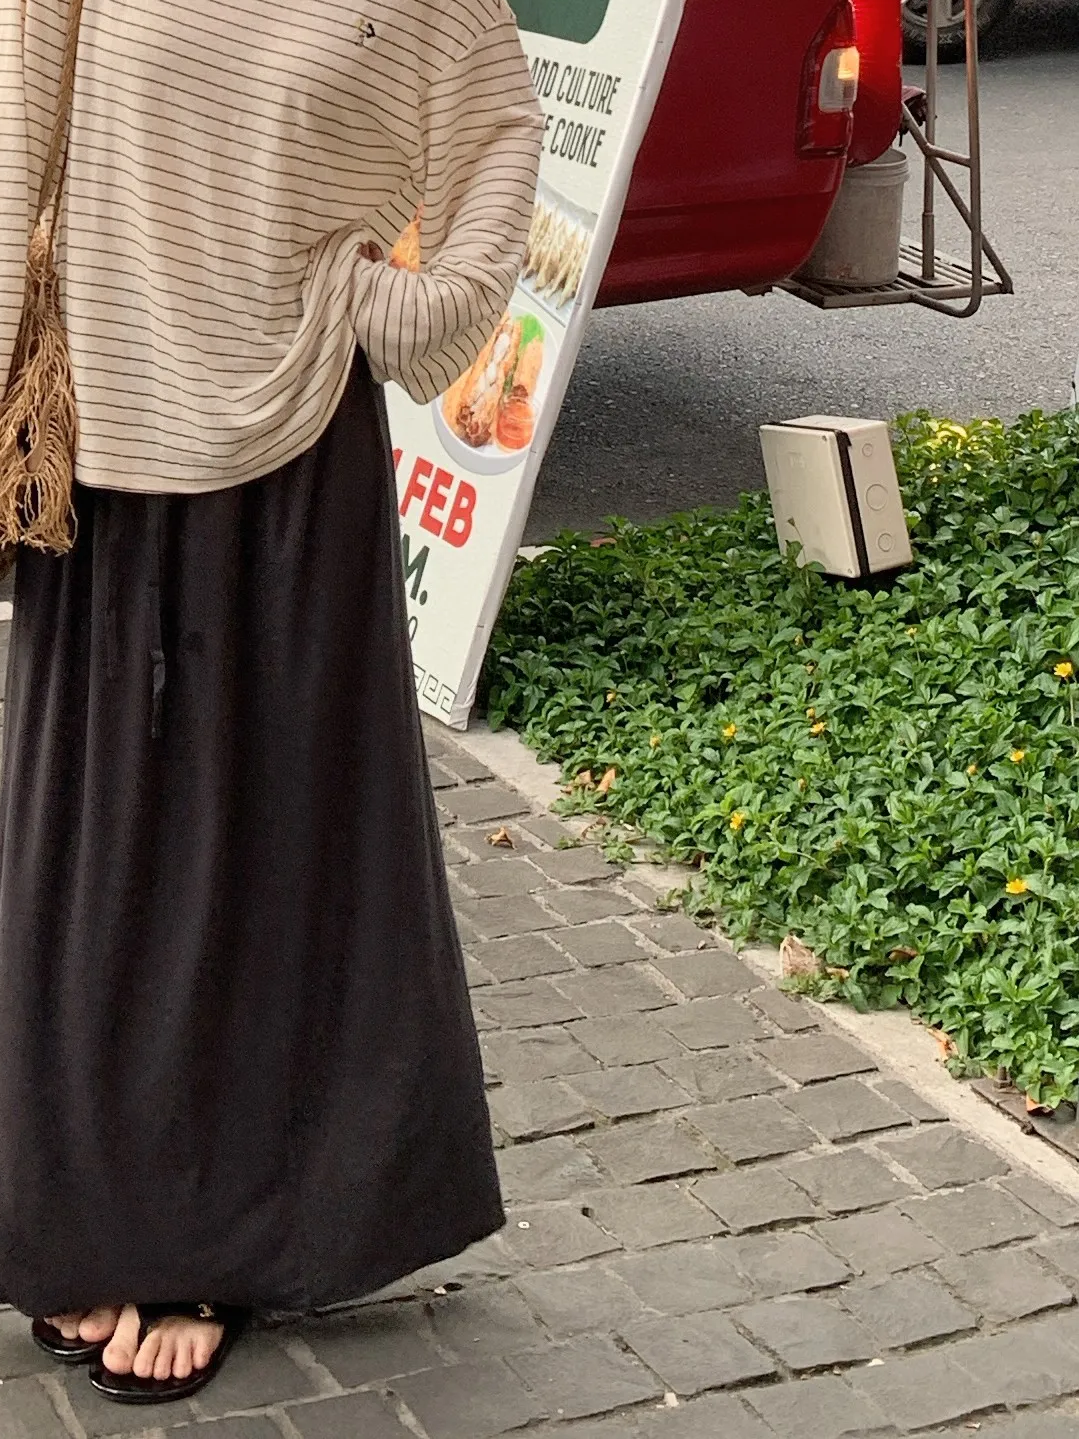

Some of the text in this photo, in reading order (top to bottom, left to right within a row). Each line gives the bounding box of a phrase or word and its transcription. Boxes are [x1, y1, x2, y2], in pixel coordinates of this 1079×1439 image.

[556, 65, 622, 116] CULTURE
[550, 118, 606, 168] COOKIE
[399, 456, 477, 549] FEB
